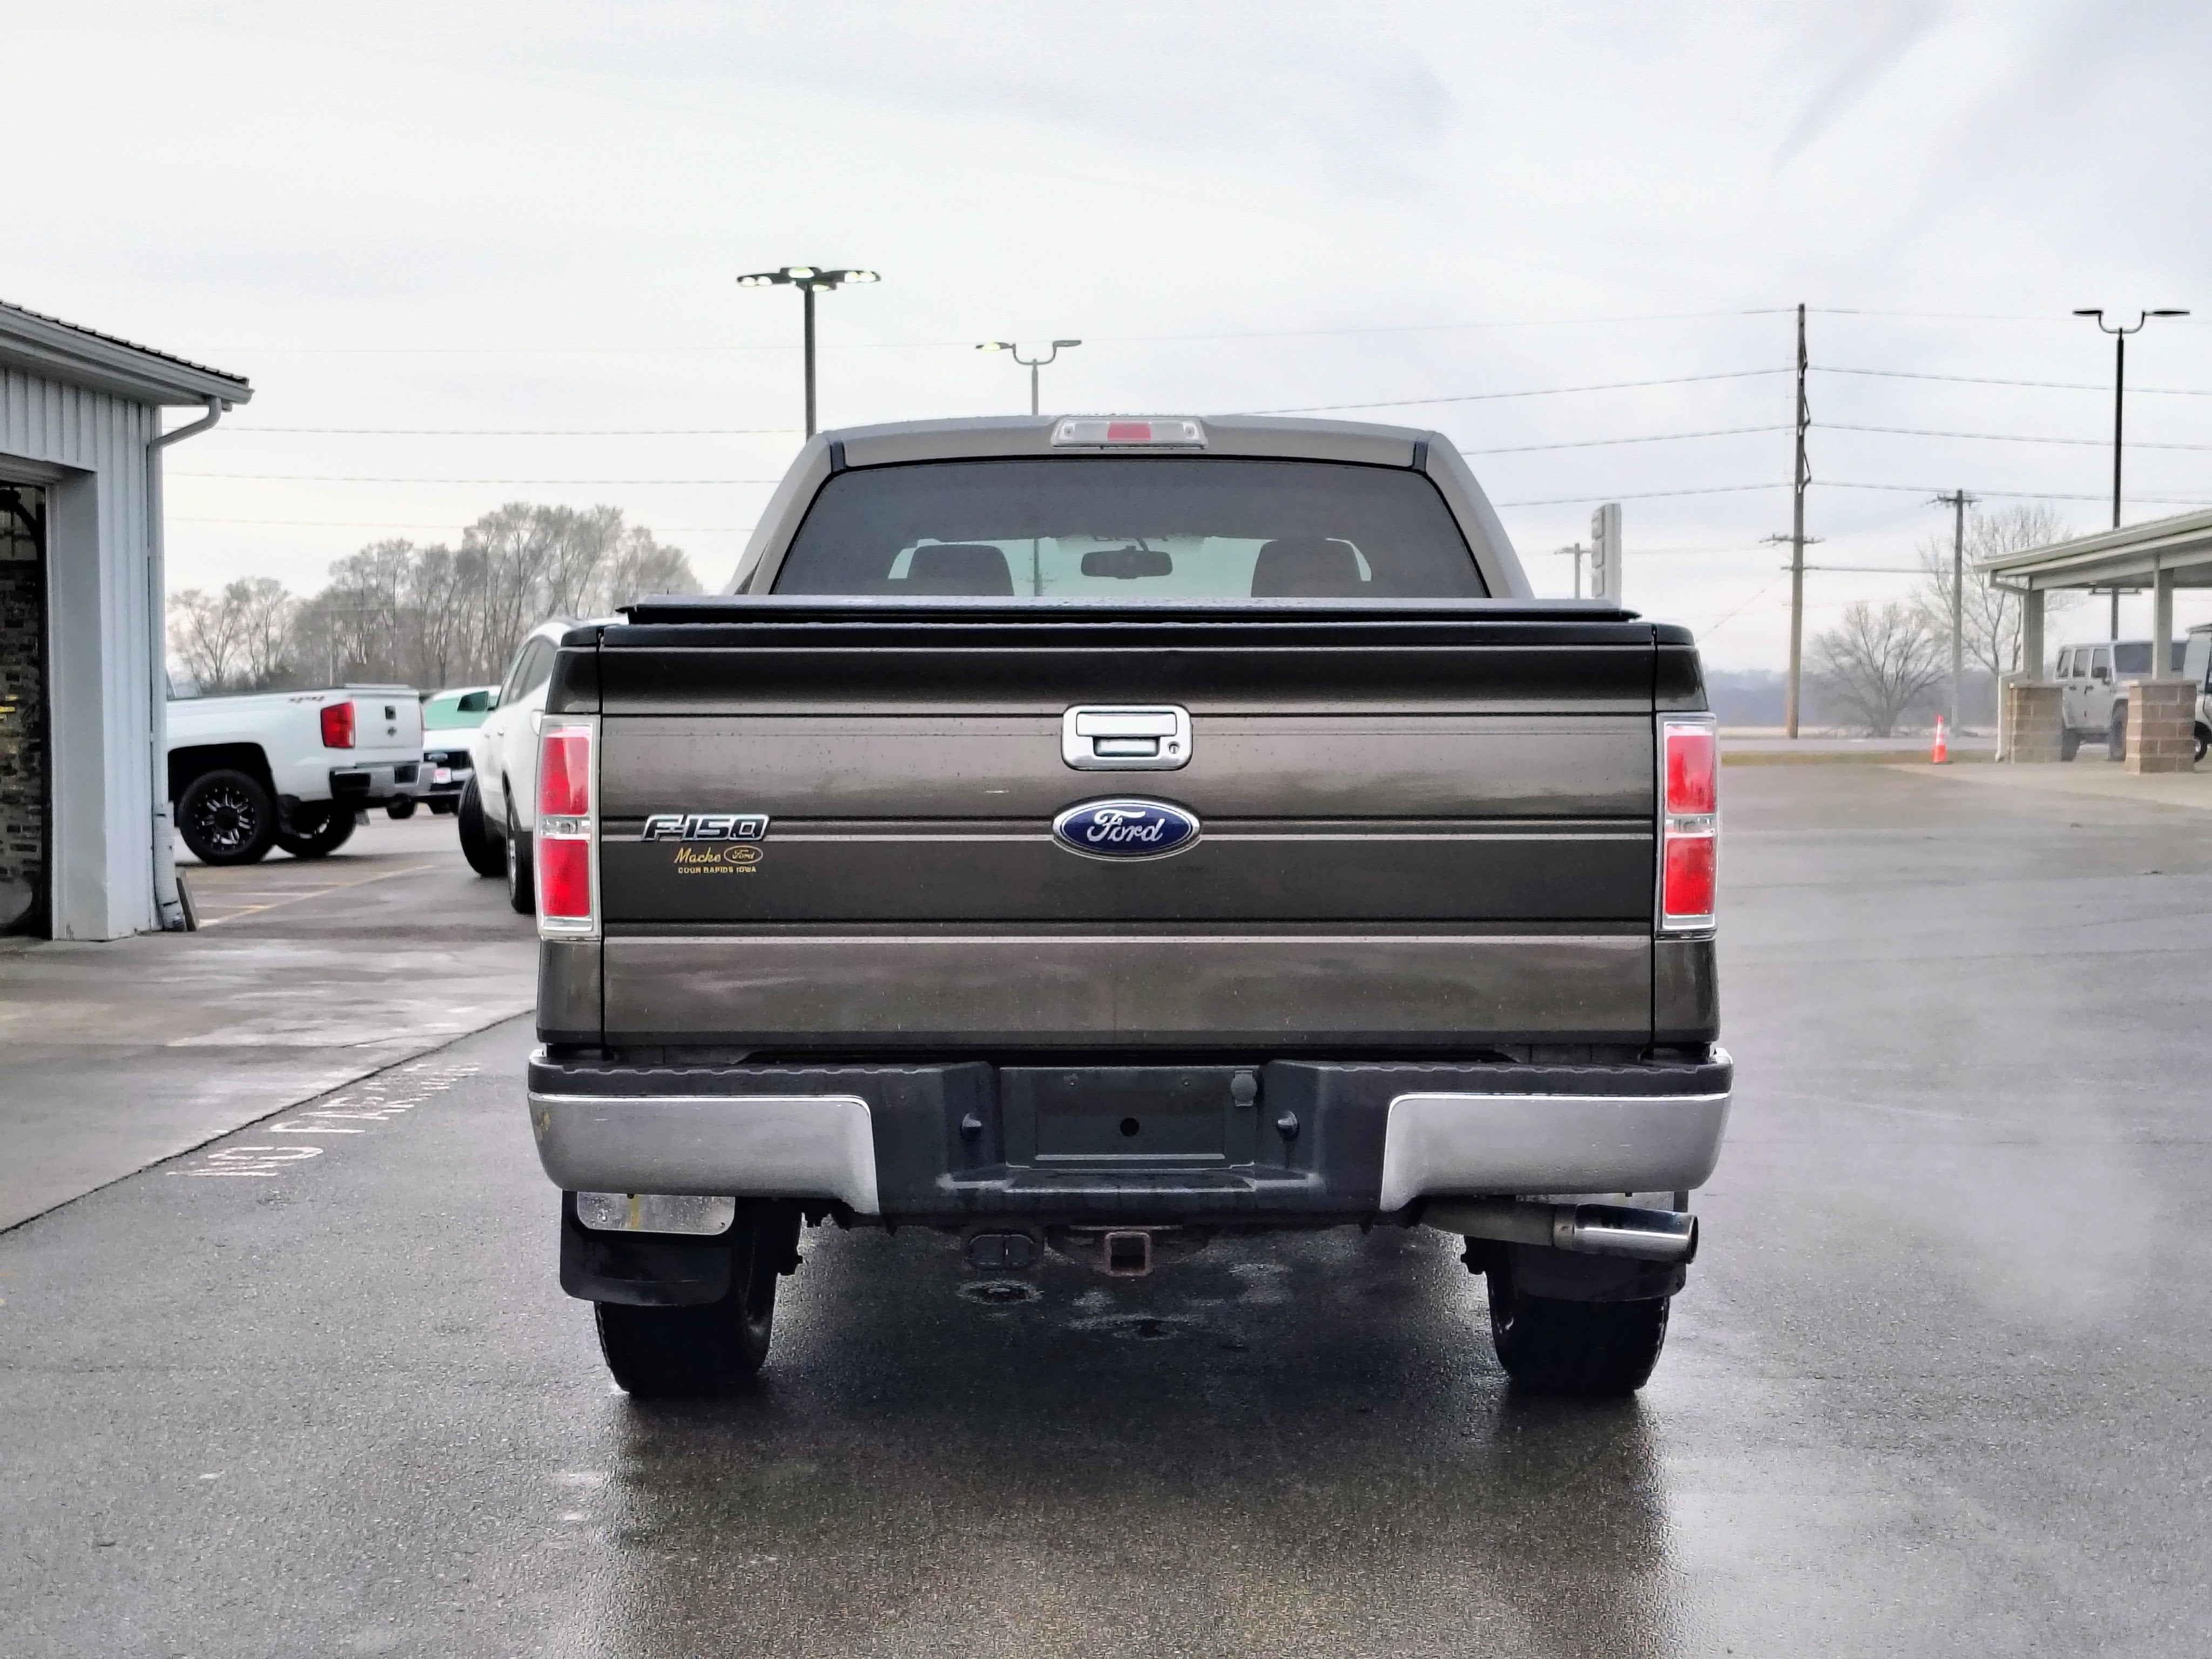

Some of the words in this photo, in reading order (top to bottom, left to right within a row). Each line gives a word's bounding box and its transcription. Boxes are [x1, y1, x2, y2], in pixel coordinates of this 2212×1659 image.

[642, 814, 770, 841] F-150
[1086, 809, 1166, 842] Ford
[732, 849, 755, 860] Ford
[703, 866, 733, 874] RAPIDS
[166, 1145, 324, 1176] NO
